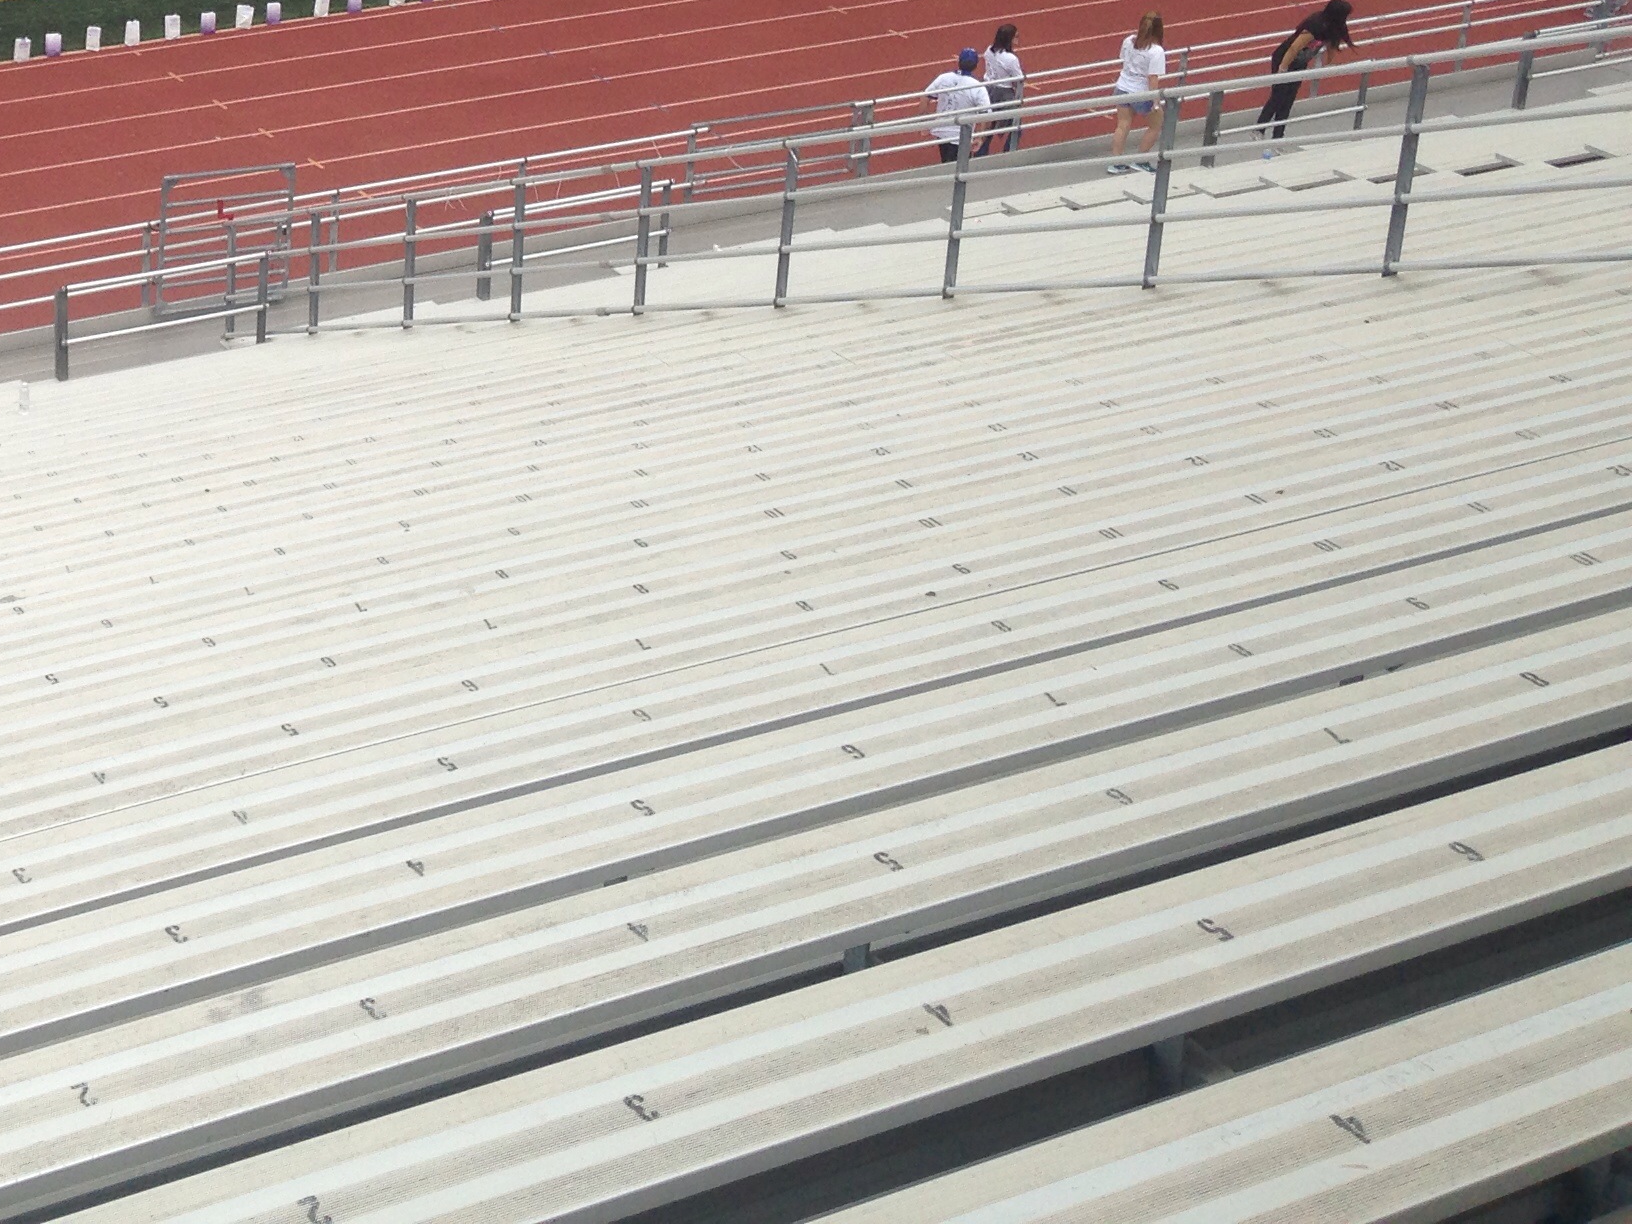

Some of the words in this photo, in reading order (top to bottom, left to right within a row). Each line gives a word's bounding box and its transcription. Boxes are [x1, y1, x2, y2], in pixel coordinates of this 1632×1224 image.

[951, 563, 972, 575] 9
[1157, 579, 1180, 591] 9
[1405, 596, 1430, 611] 9
[990, 620, 1013, 633] 8
[634, 638, 652, 651] 7
[1519, 671, 1550, 688] 8
[1044, 692, 1067, 708] 7
[631, 708, 652, 721] 6
[280, 724, 300, 737] 5
[1323, 727, 1352, 745] 7
[841, 744, 866, 759] 6
[436, 756, 459, 772] 5
[1105, 787, 1134, 806] 6
[630, 799, 655, 817] 5
[231, 810, 249, 825] 4
[1448, 841, 1485, 862] 6
[405, 860, 424, 877] 4
[873, 851, 904, 872] 5
[11, 868, 33, 884] 3
[163, 924, 190, 944] 3
[626, 922, 649, 943] 4
[1196, 918, 1235, 942] 5
[358, 997, 389, 1021] 3
[923, 1004, 953, 1027] 4
[70, 1081, 99, 1108] 2
[623, 1094, 660, 1122] 3
[1329, 1114, 1371, 1145] 4
